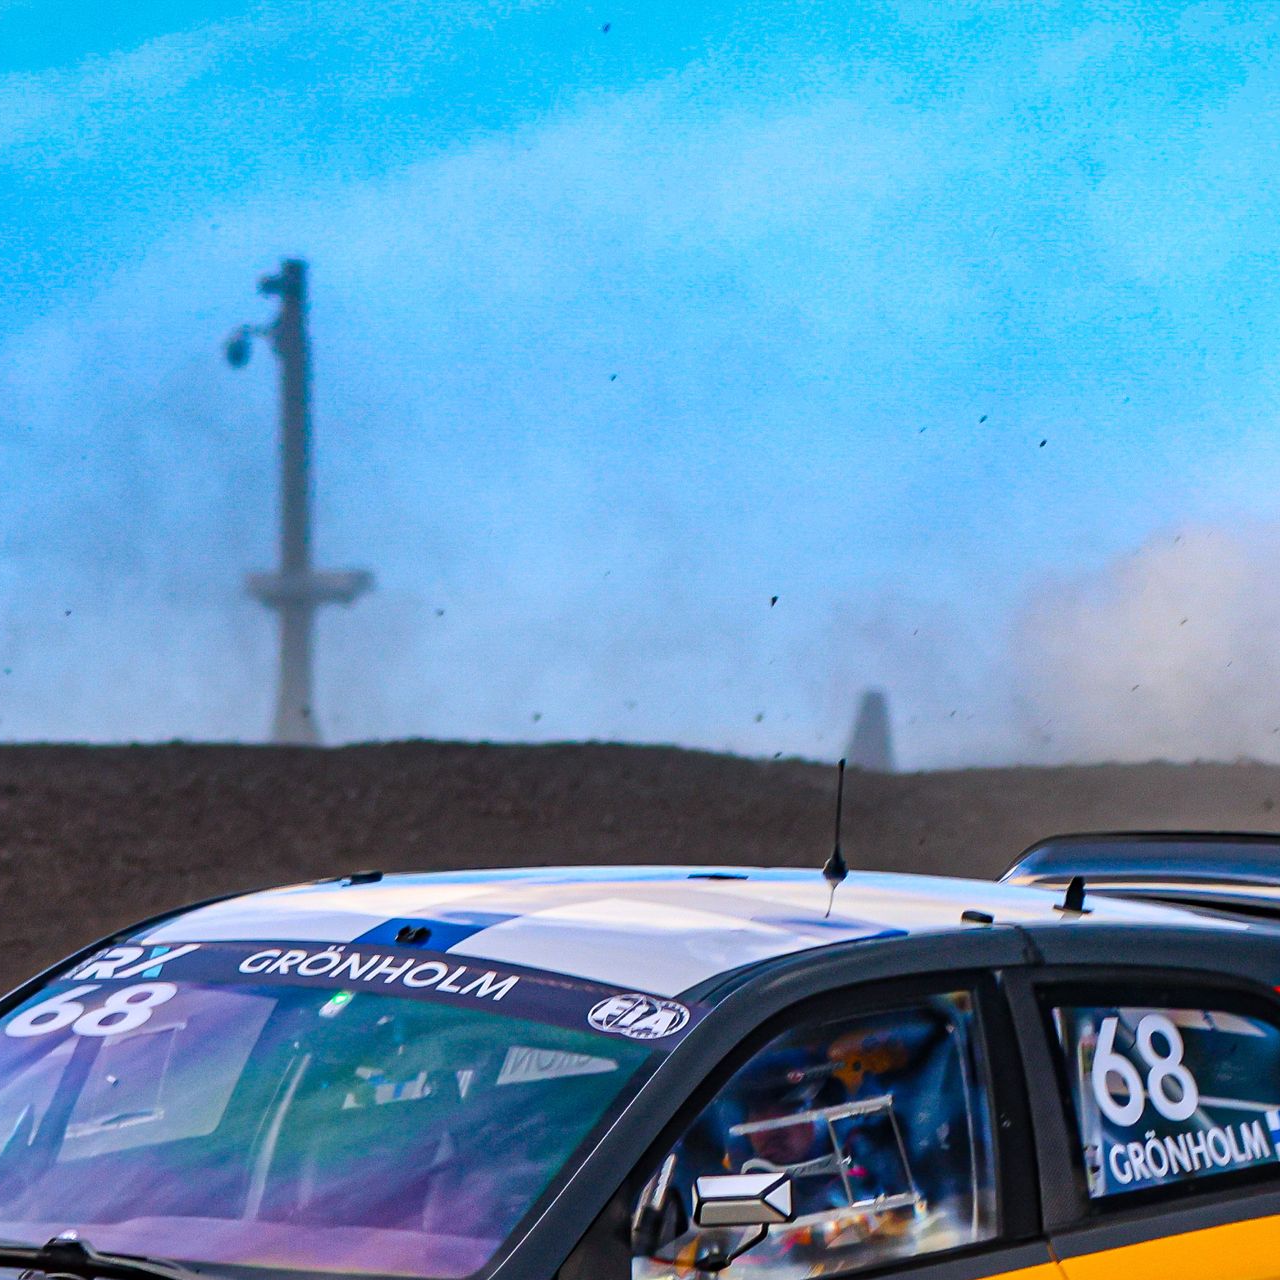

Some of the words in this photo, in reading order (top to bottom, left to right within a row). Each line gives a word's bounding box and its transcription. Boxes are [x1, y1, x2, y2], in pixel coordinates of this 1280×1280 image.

[71, 943, 202, 980] RX
[239, 945, 519, 1001] GRÖNHOLM
[5, 981, 178, 1038] 68
[588, 994, 690, 1040] FIA
[1092, 1014, 1199, 1127] 68
[1109, 1118, 1271, 1184] GRÖNHOLM
